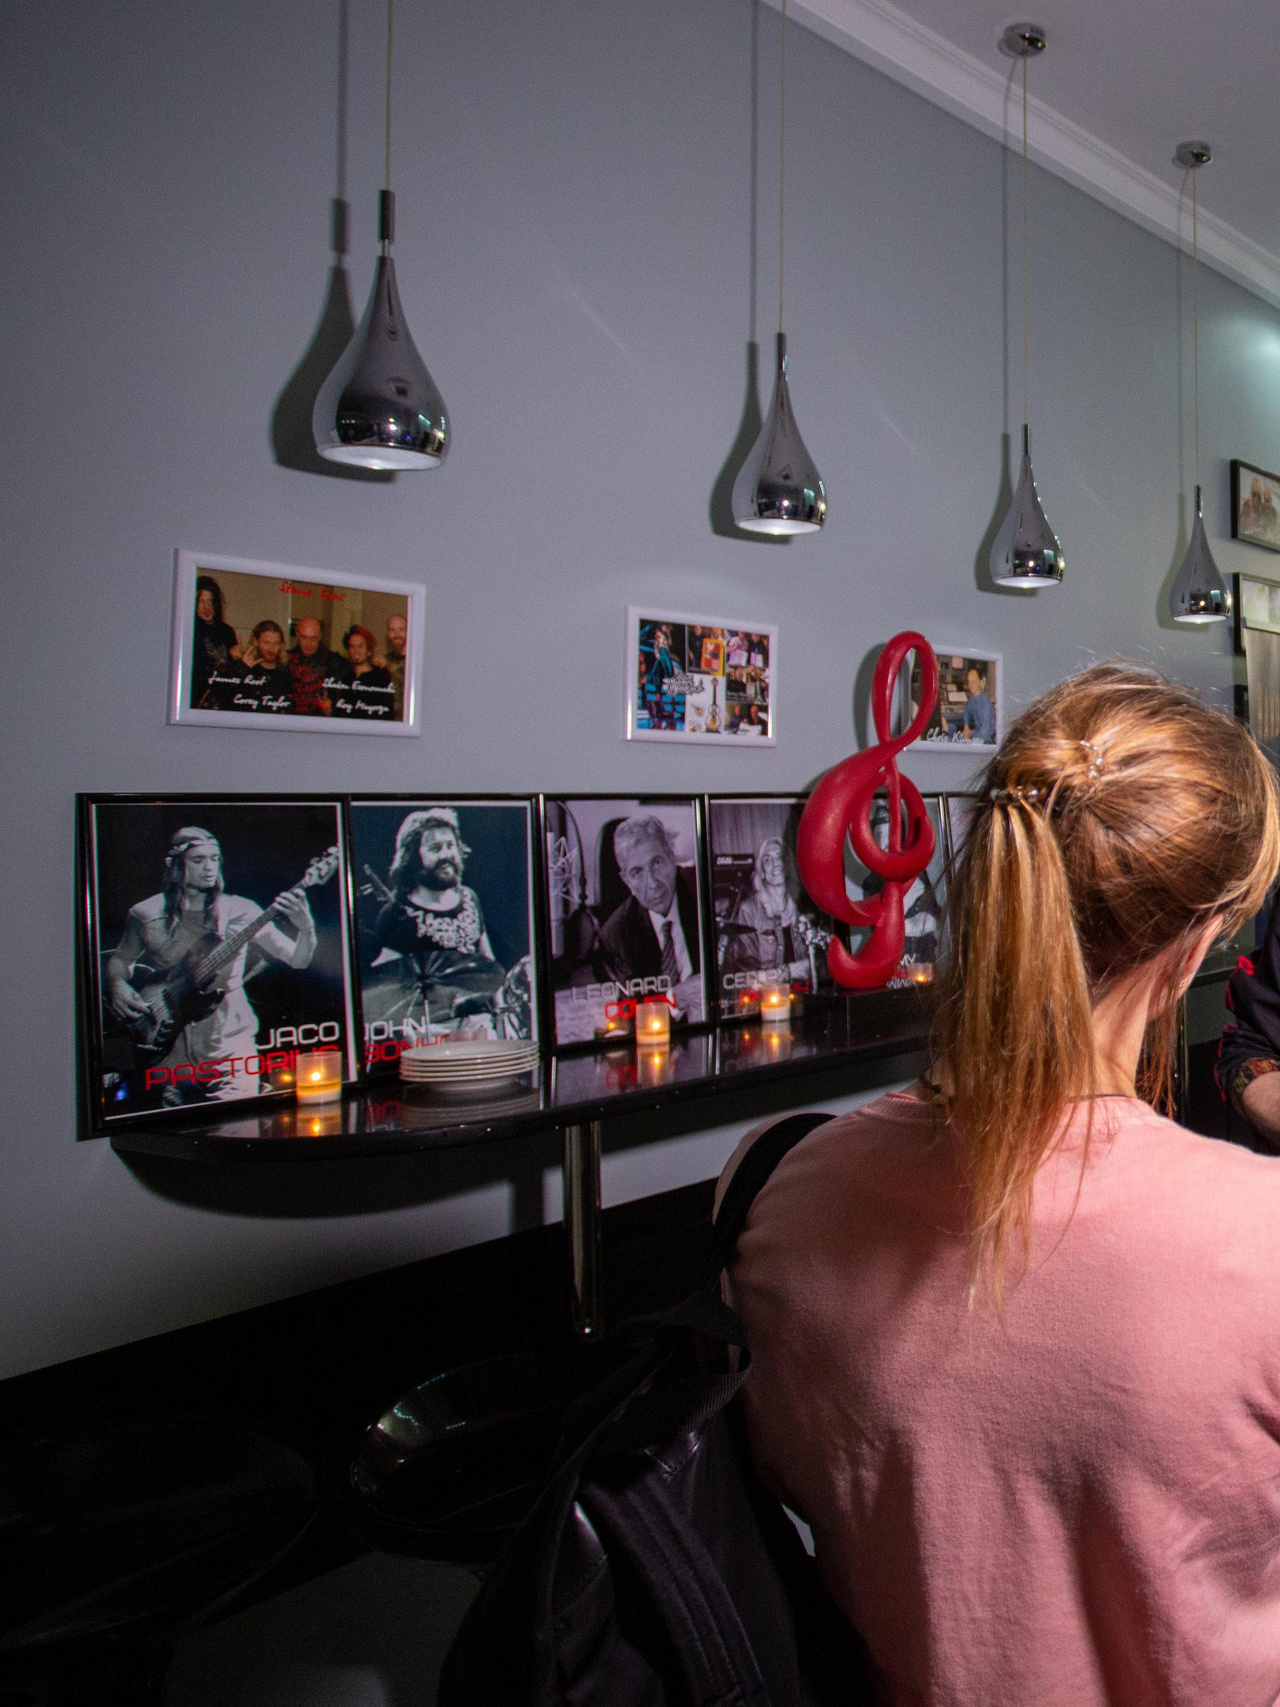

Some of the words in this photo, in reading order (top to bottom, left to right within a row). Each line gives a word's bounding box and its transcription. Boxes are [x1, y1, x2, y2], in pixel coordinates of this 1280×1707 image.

[244, 675, 267, 685] Root
[262, 696, 291, 710] Taylor
[572, 975, 671, 1003] LEONARD
[255, 1021, 340, 1050] JACO
